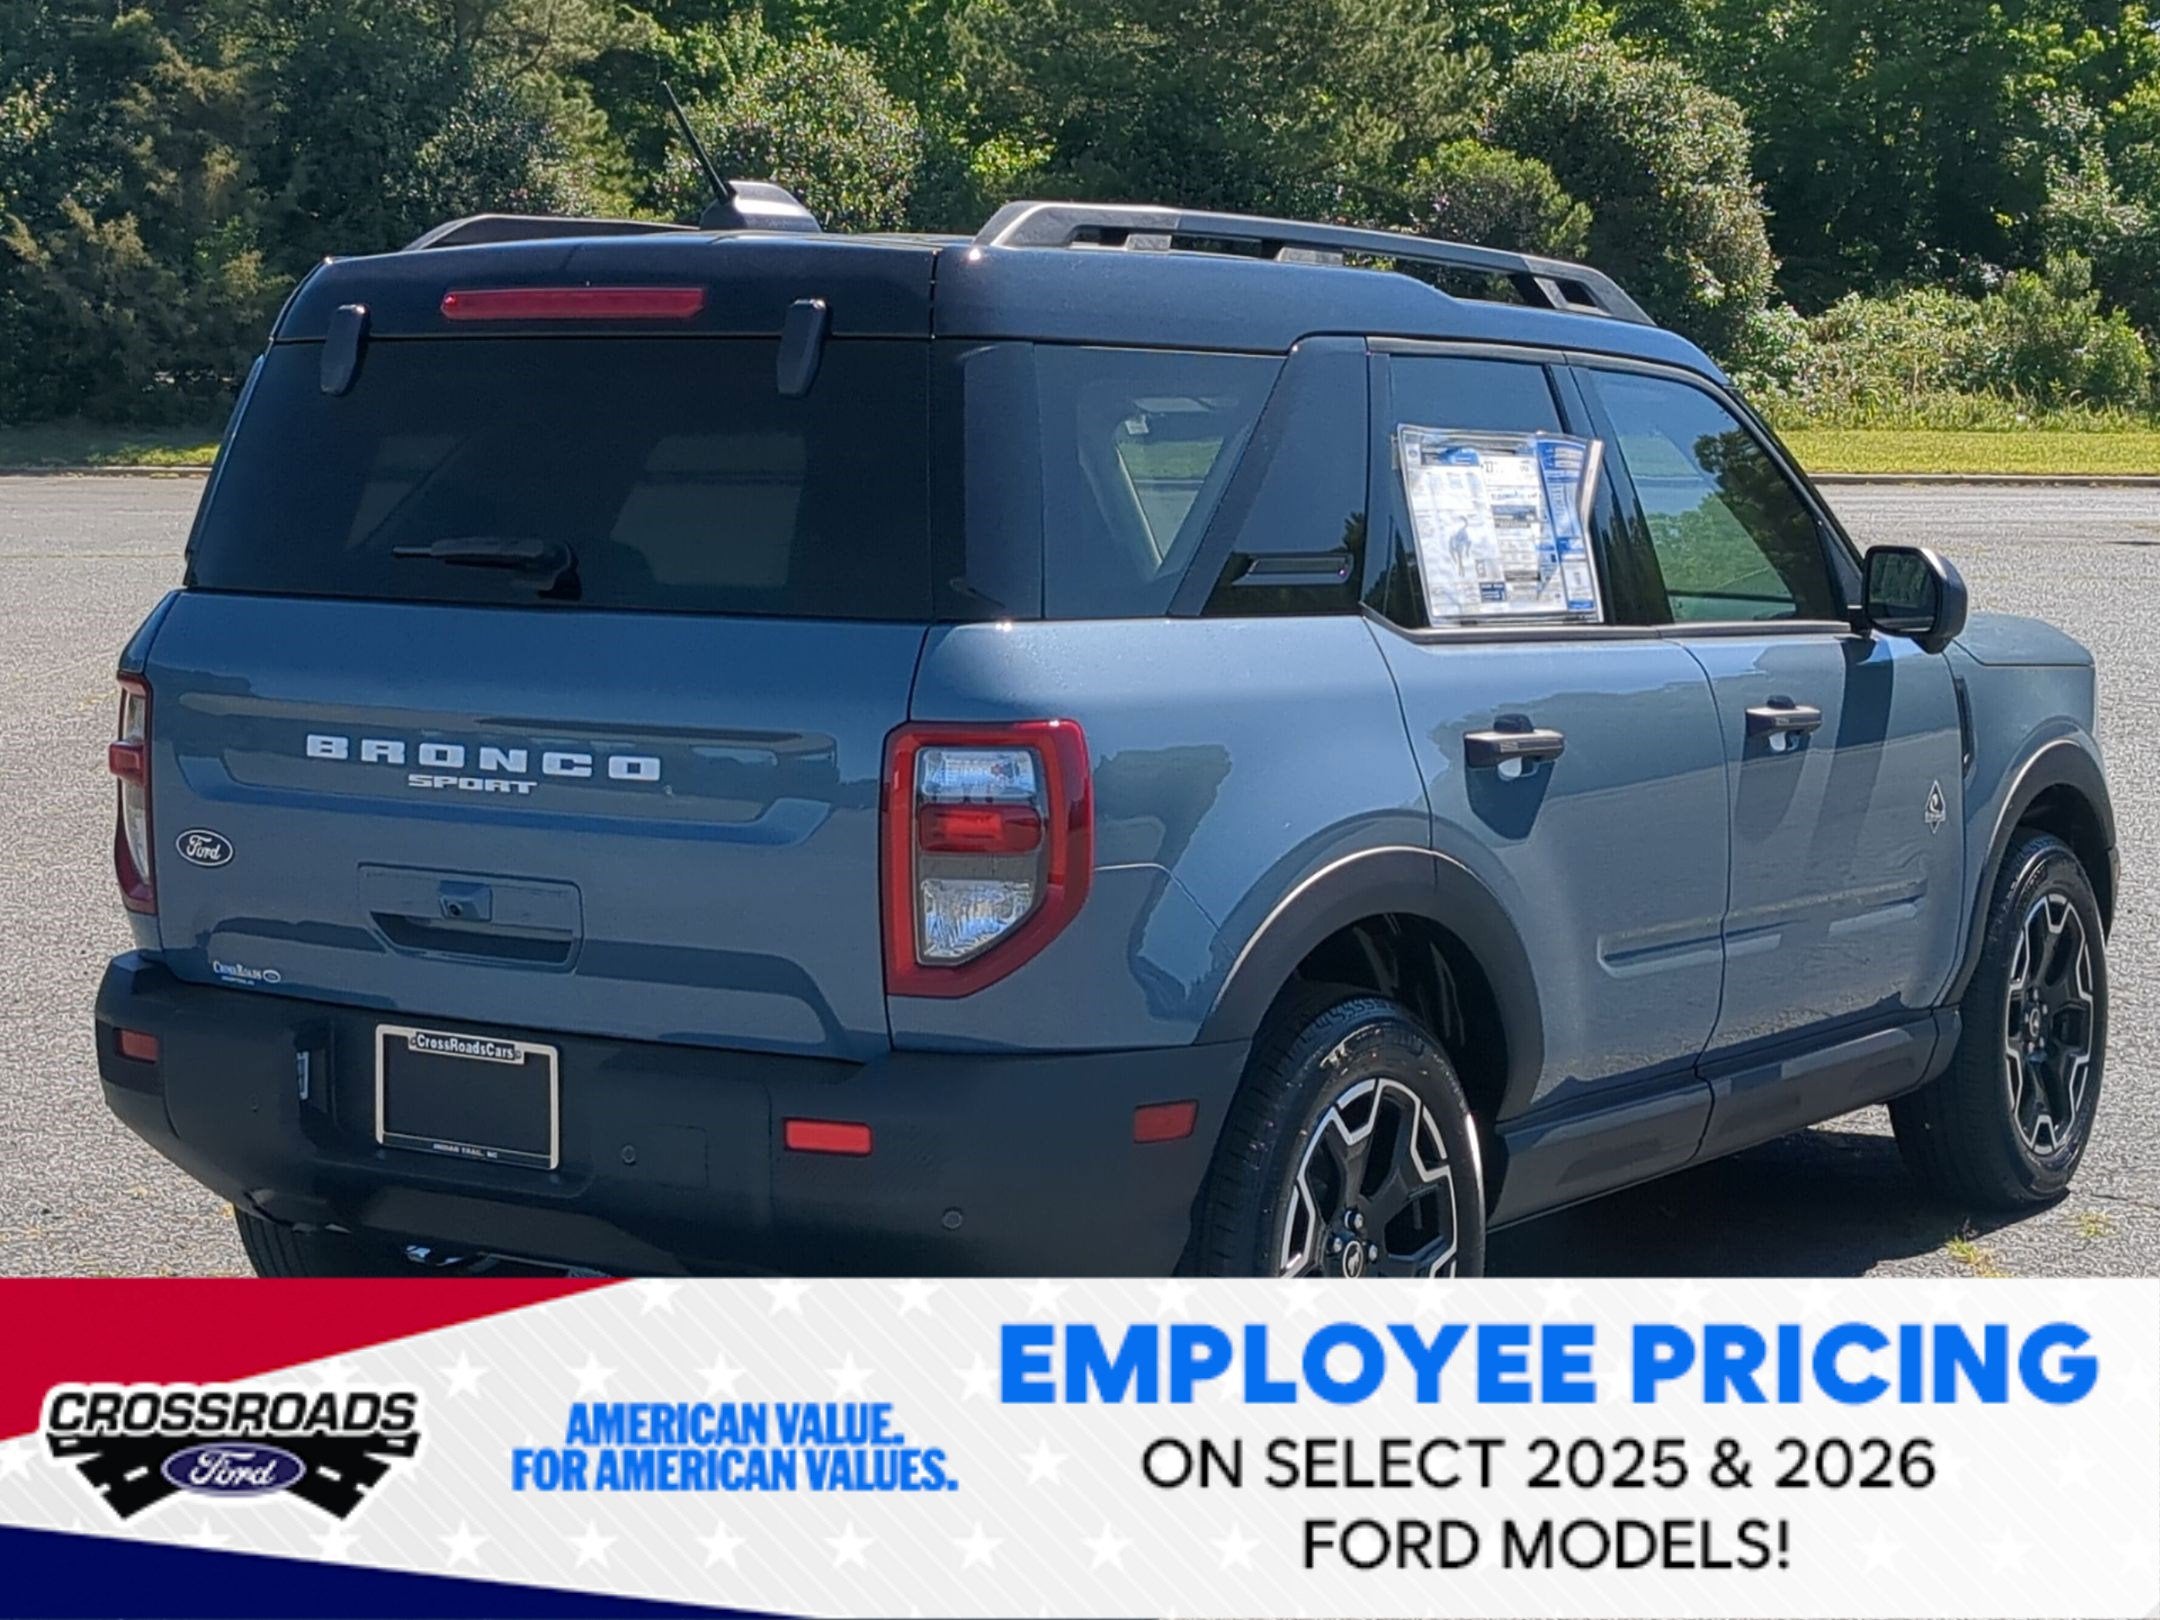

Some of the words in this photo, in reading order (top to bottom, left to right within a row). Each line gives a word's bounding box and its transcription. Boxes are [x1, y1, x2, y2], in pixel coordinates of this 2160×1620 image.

[306, 734, 660, 781] BRONCO
[408, 774, 537, 794] SPORT
[186, 834, 221, 861] Ford
[416, 1034, 514, 1060] CrossRoadsCars
